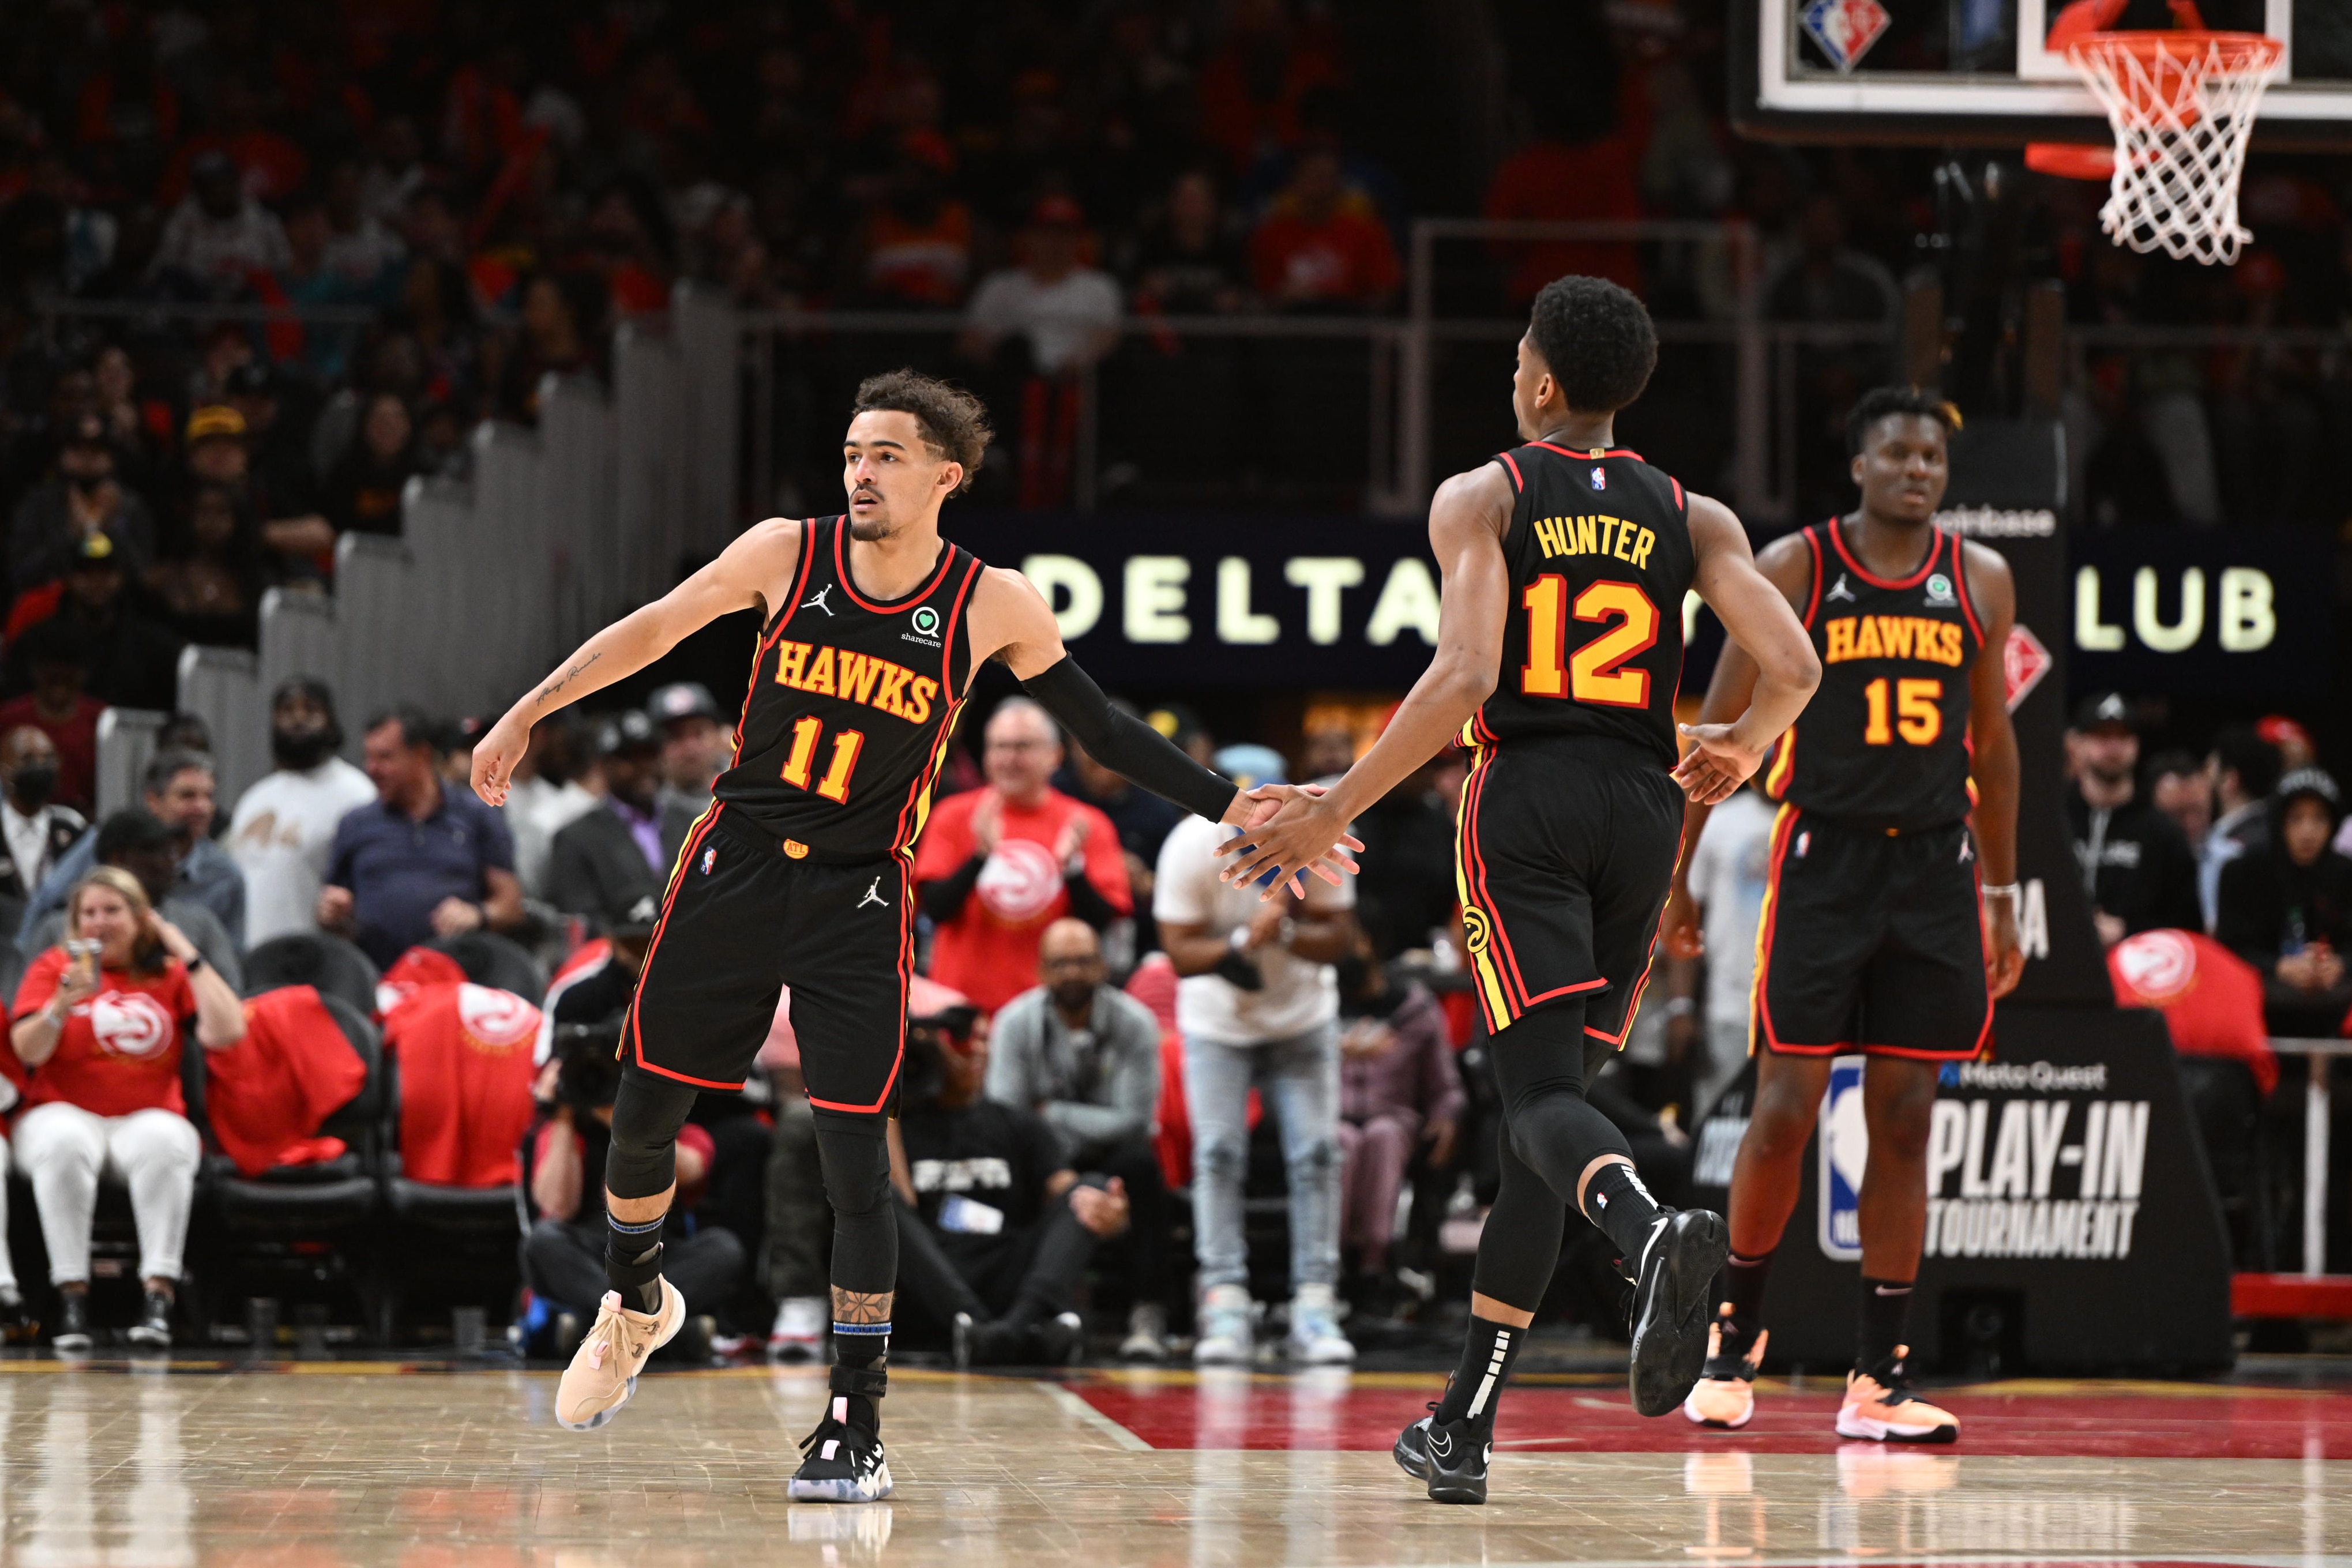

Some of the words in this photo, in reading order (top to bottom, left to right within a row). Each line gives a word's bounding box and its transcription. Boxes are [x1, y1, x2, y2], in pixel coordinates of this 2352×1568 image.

[1534, 514, 1655, 570] HUNTER
[1021, 554, 1442, 646] DELTA
[2075, 566, 2276, 652] LUB
[901, 633, 941, 648] sharecare
[1521, 573, 1660, 709] 12
[1825, 615, 1962, 667] HAWKS
[775, 639, 940, 724] HAWKS
[1864, 678, 1943, 746] 15
[780, 715, 865, 805] 11
[787, 842, 805, 853] ATL
[2028, 1060, 2108, 1092] Quest
[1926, 1099, 2151, 1199] PLAY-IN
[1924, 1199, 2140, 1259] TOURNAMENT
